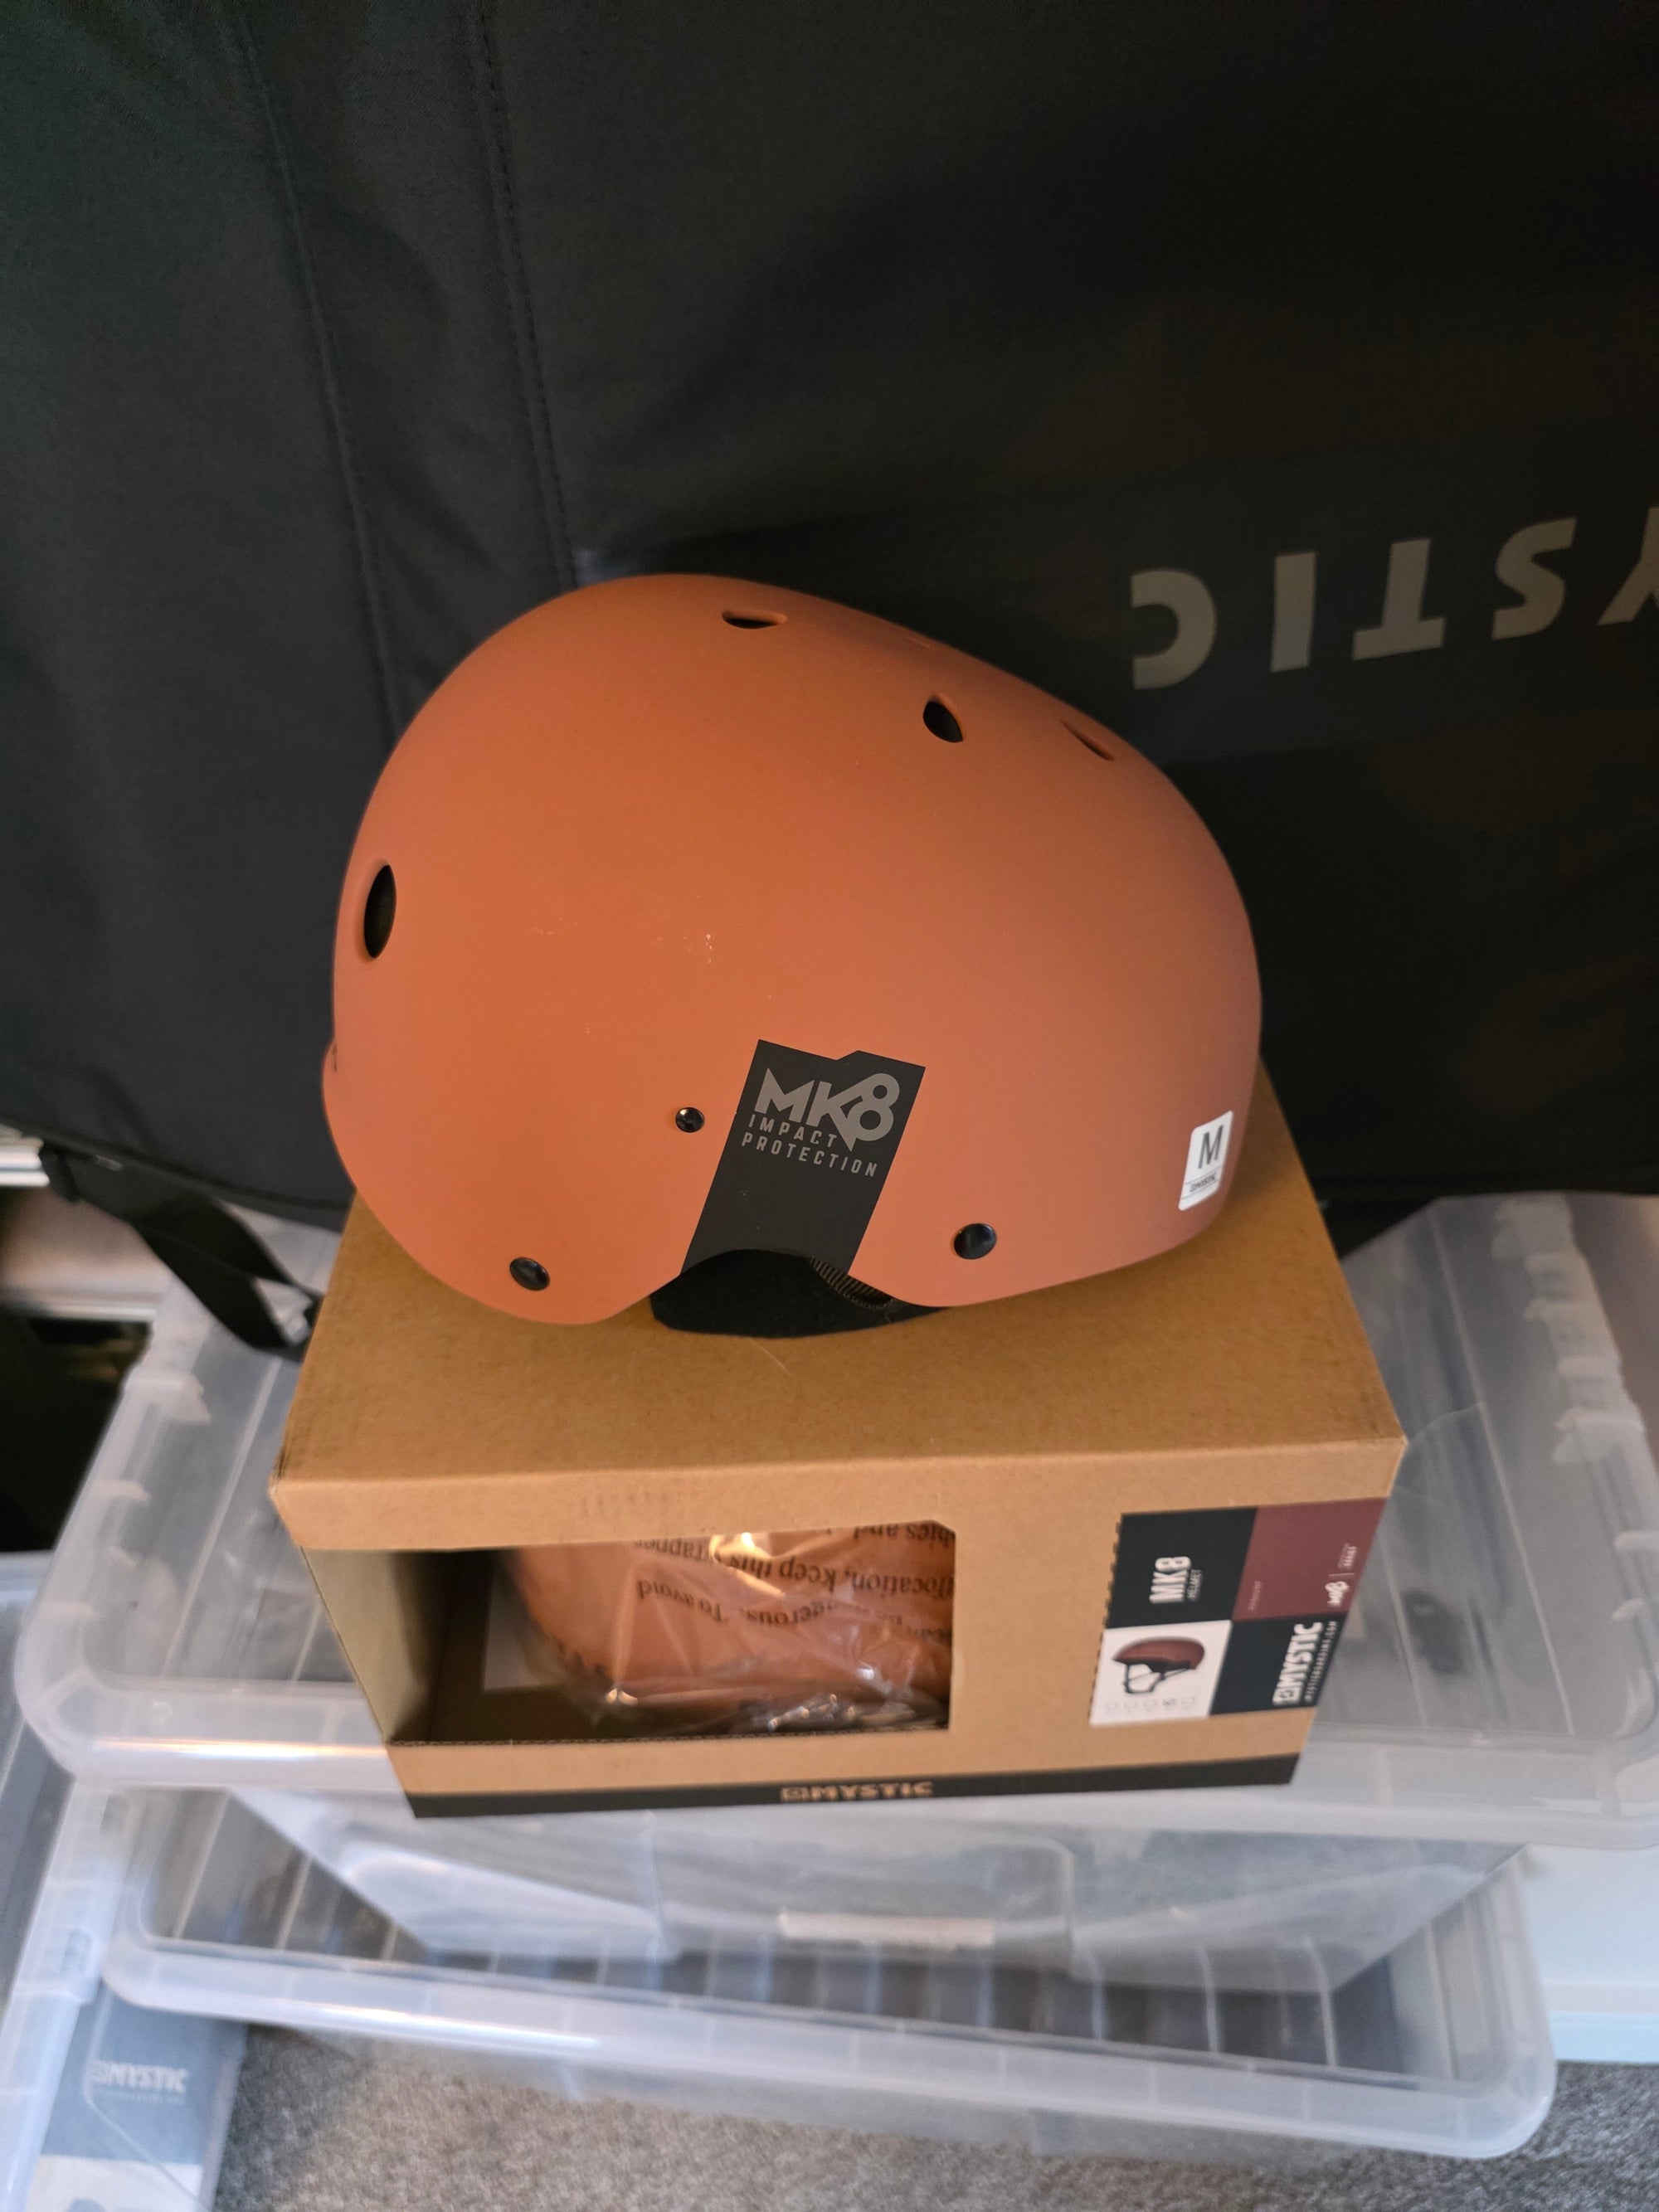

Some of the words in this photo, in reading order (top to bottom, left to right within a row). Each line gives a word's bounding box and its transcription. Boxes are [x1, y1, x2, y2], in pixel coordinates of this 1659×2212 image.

[754, 1067, 900, 1152] MK8
[748, 1114, 838, 1149] IMPACT
[1198, 1124, 1224, 1169] M
[742, 1132, 878, 1178] PROTECTION
[909, 1524, 955, 1548] bies
[729, 1553, 773, 1579] this
[780, 1556, 836, 1593] keep
[1149, 1556, 1191, 1604] MK8
[636, 1579, 694, 1607] avoid
[700, 1599, 728, 1622] To
[1275, 1621, 1325, 1689] MYSTIC
[810, 1782, 933, 1801] MYSTIC
